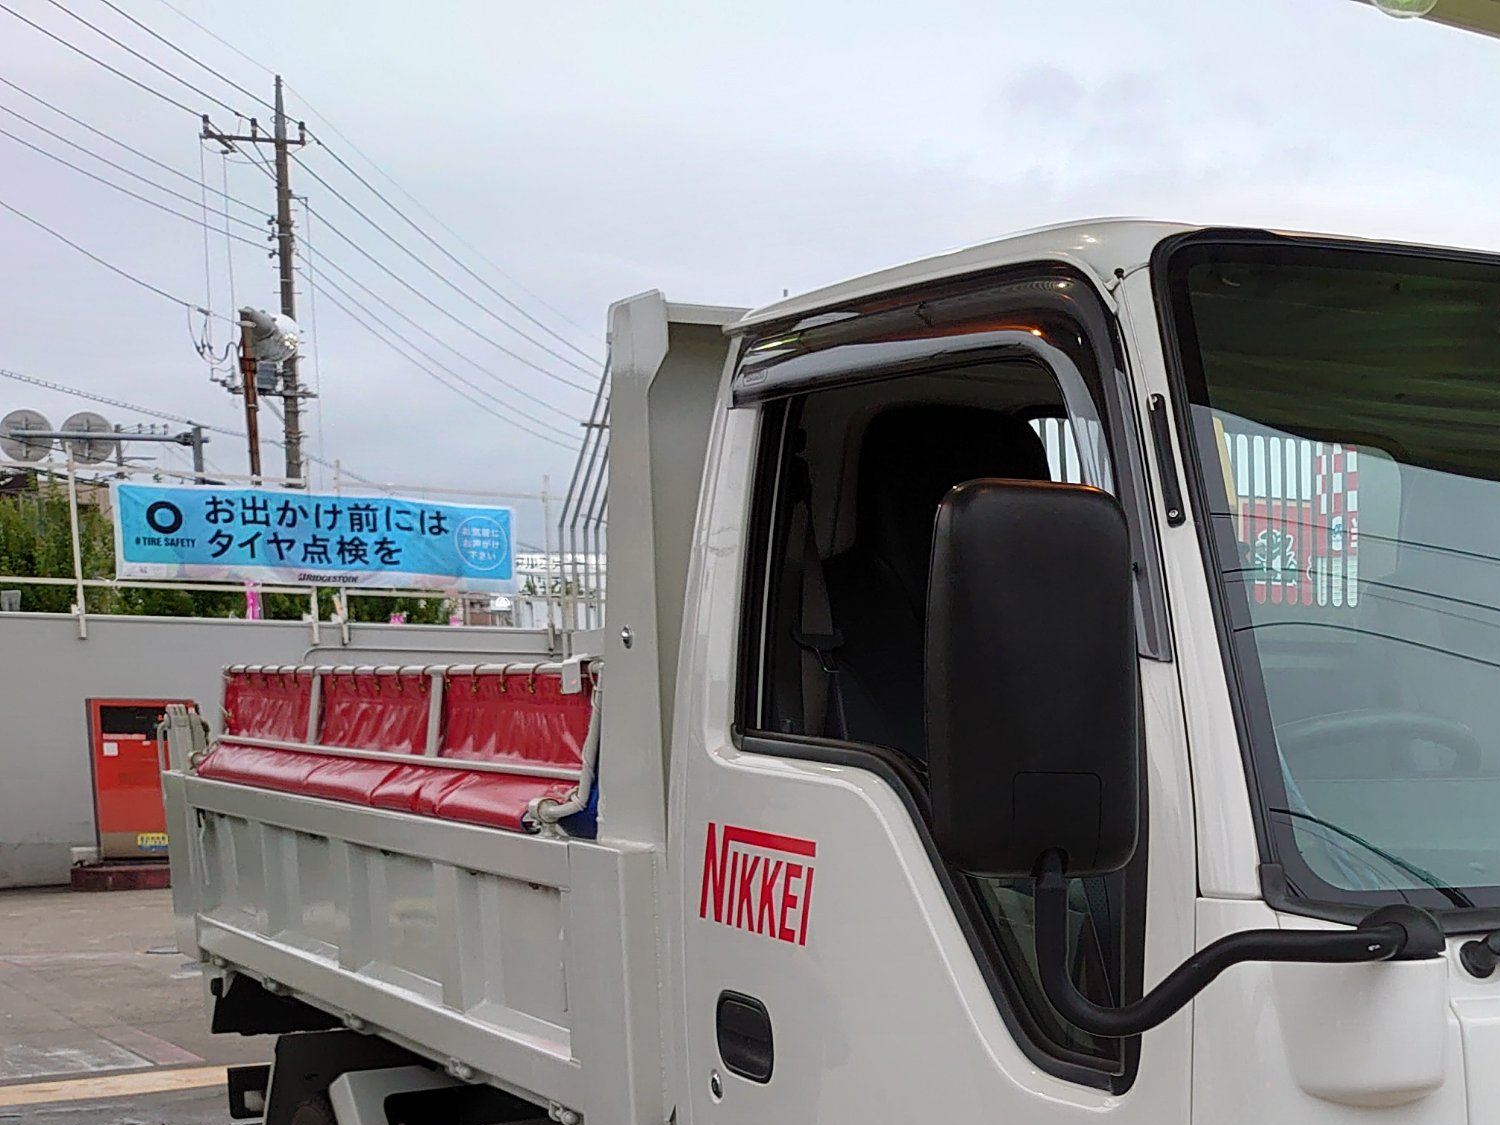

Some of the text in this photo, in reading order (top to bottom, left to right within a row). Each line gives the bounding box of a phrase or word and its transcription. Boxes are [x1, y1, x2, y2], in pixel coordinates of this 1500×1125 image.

[204, 495, 449, 536] お出かけ前には
[164, 537, 196, 549] SAFETY
[207, 528, 402, 566] タイヤ点検を
[699, 821, 817, 947] NIKKEI
